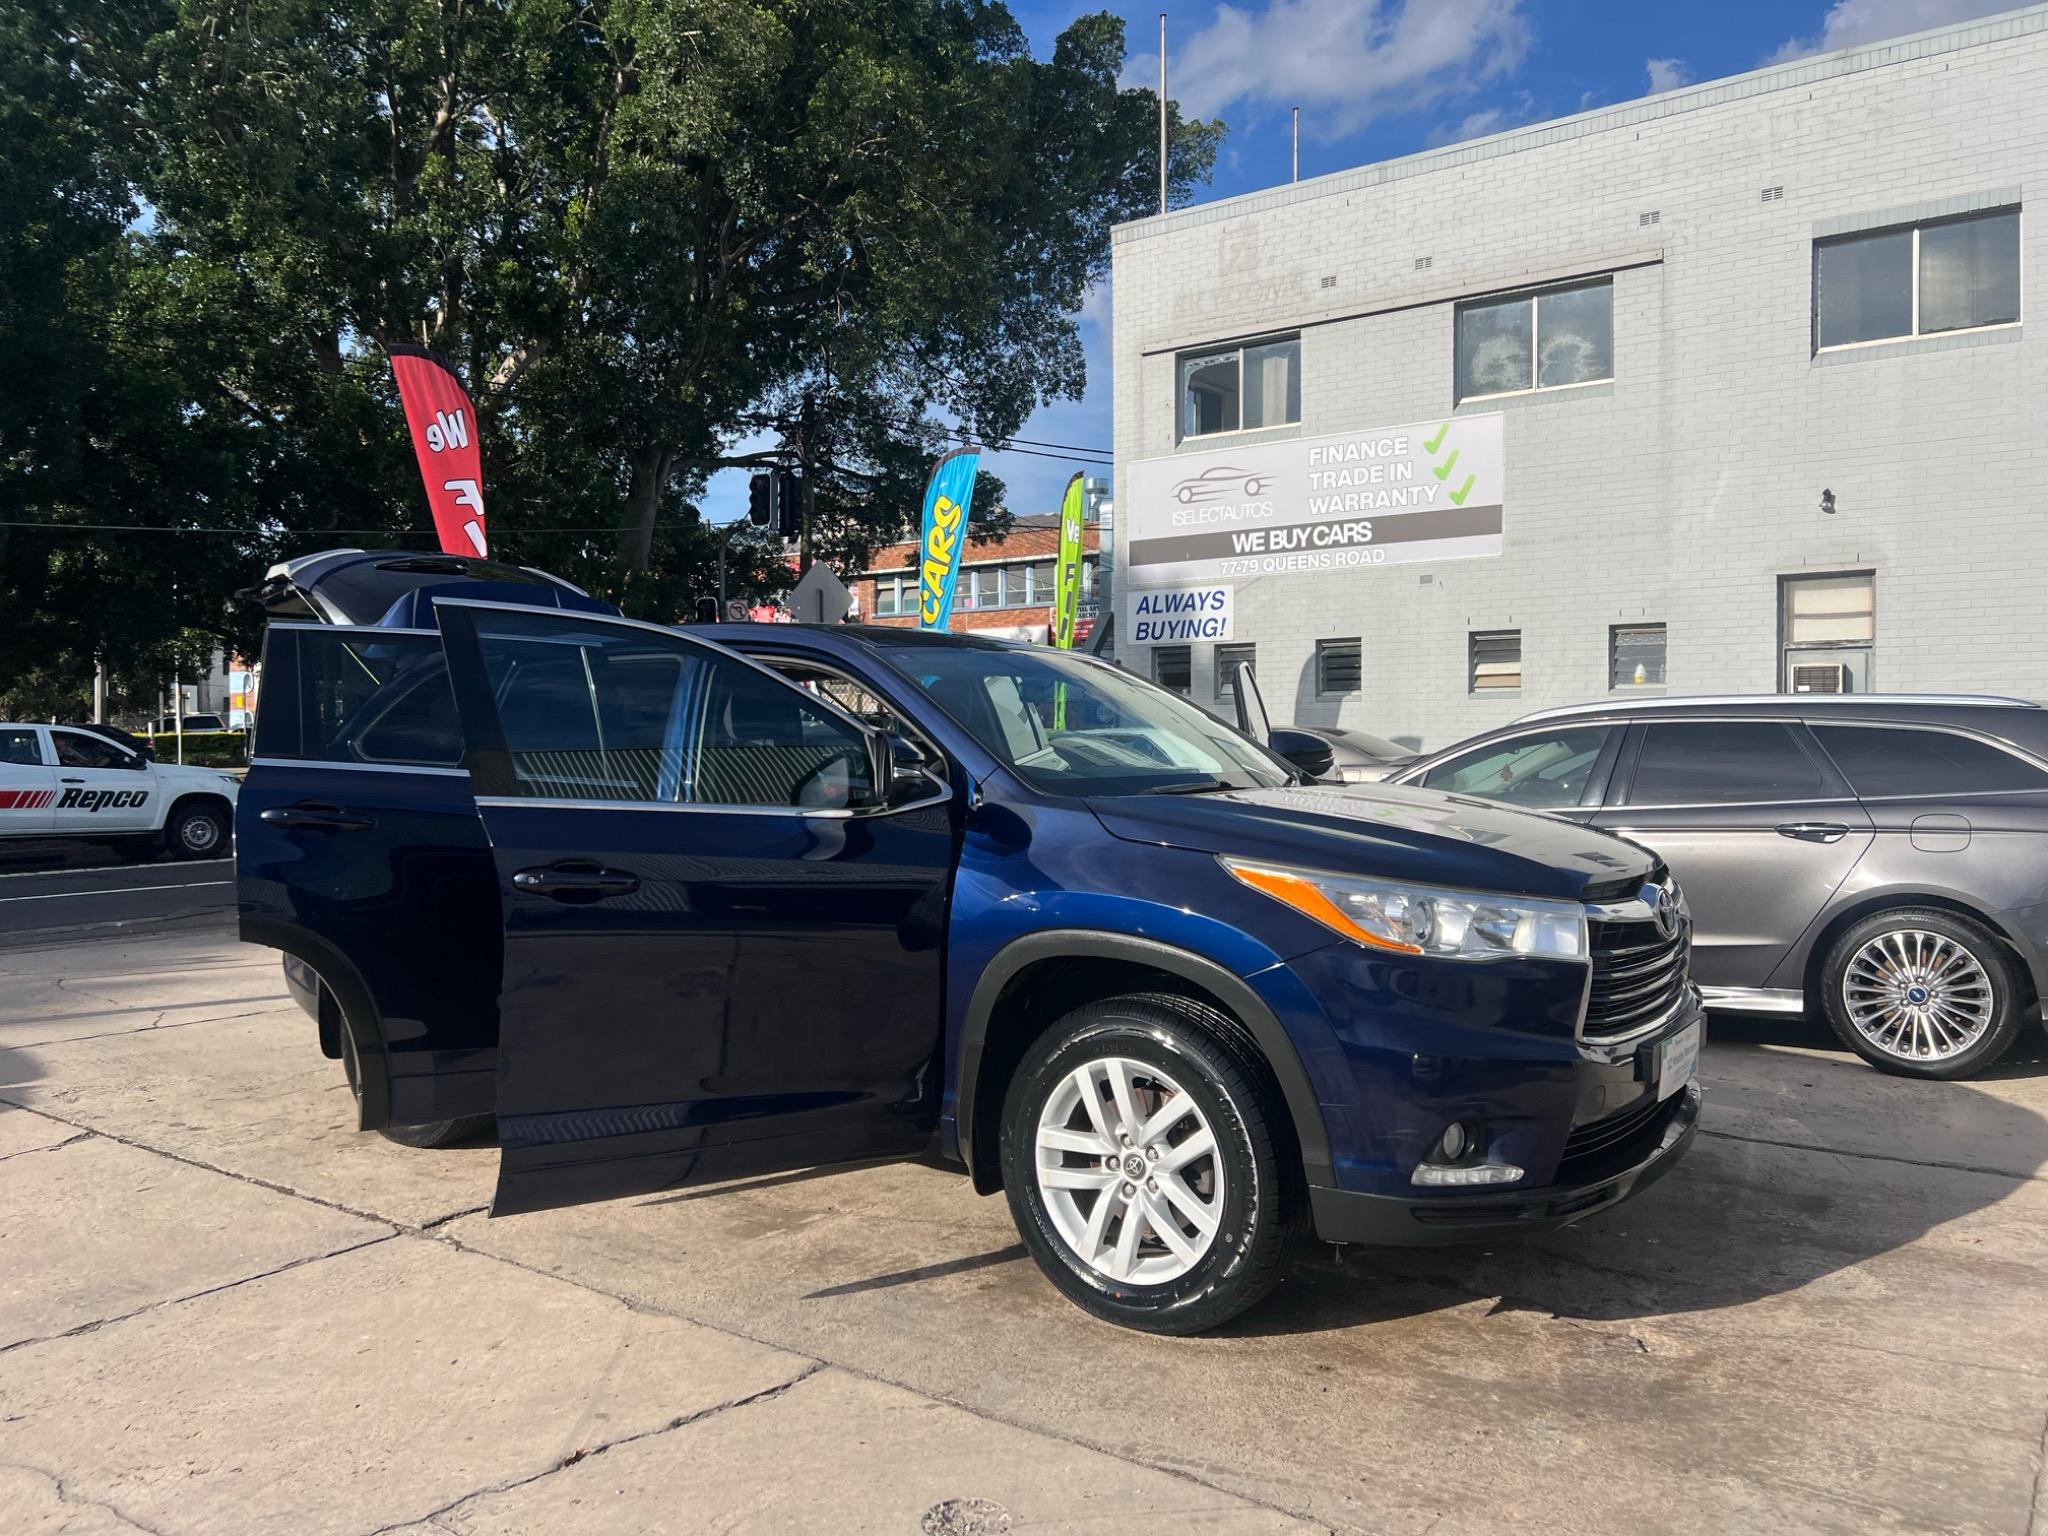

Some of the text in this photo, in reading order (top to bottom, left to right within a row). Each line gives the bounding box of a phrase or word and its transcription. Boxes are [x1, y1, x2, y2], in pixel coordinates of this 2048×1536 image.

[1309, 436, 1408, 466] FINANCE
[1309, 461, 1413, 491] TRADE IN
[1309, 483, 1441, 515] WARRANTY
[1172, 501, 1273, 527] ISELECTAUTOS
[1232, 521, 1373, 553] WE BUY CARS
[920, 495, 962, 625] CARS
[1220, 549, 1386, 576] 77-79 QUEENS ROAD
[1136, 590, 1225, 615] ALWAYS
[1135, 617, 1226, 641] BUYING!
[56, 788, 149, 812] Repco
